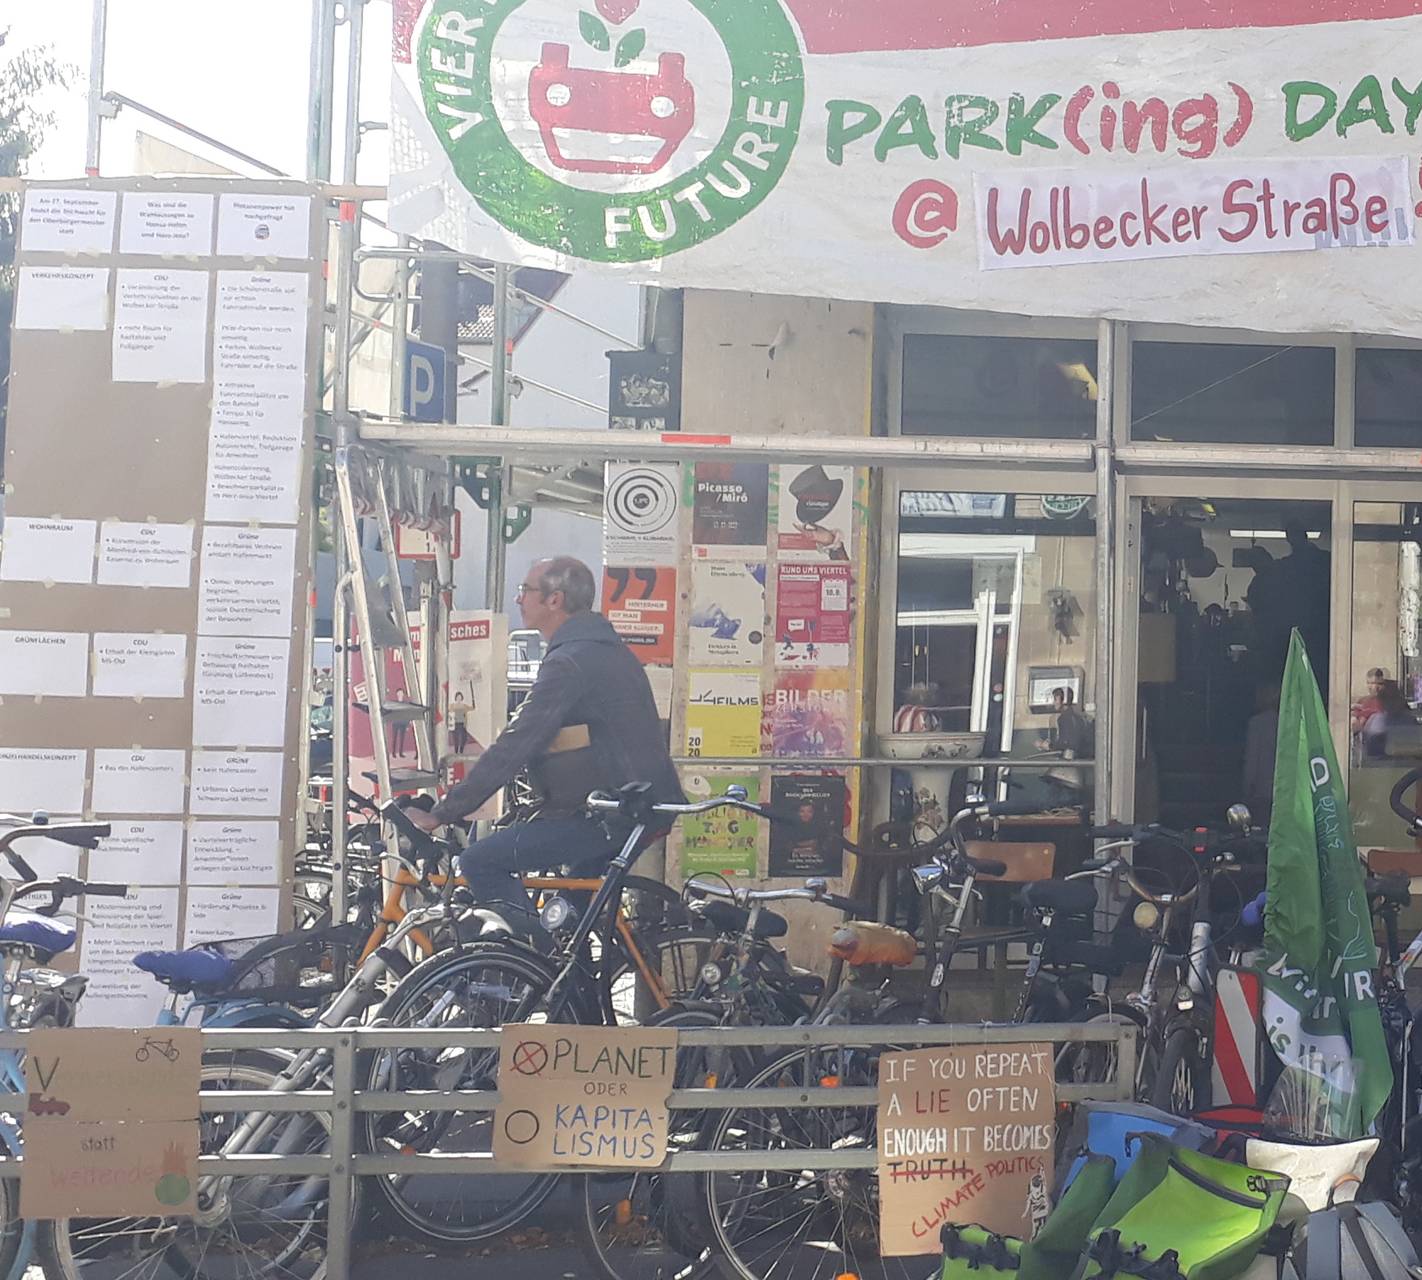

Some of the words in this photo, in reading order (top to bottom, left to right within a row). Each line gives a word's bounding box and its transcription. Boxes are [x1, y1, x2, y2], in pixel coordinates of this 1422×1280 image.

[432, 0, 497, 140] VIER
[825, 80, 1254, 167] PARK(ing)
[603, 95, 791, 249] FUTURE
[892, 178, 960, 249] @
[985, 176, 1209, 256] Wolbecker
[1217, 171, 1391, 243] Straße
[409, 354, 435, 417] P
[697, 483, 744, 493] Picasso
[780, 566, 802, 575] RUND
[818, 566, 848, 576] VIERTEL
[450, 623, 488, 639] sches
[688, 737, 701, 746] 20
[688, 748, 700, 757] 20
[553, 1038, 673, 1079] PLANET
[885, 1058, 917, 1082] IF
[929, 1057, 966, 1080] YOU
[974, 1052, 1048, 1079] REPEAT
[583, 1081, 628, 1096] ODER
[887, 1092, 902, 1116] A
[915, 1088, 951, 1114] LIE
[967, 1086, 1039, 1113] OFTEN
[555, 1103, 665, 1130] KAPITA-
[553, 1131, 656, 1160] LISMUS
[884, 1126, 948, 1157] ENOUGH
[953, 1127, 976, 1154] IT
[983, 1123, 1051, 1152] BECOMES
[887, 1157, 969, 1184] TRUTH
[911, 1173, 986, 1239] CLIMATE
[984, 1155, 1043, 1179] POLITICS
